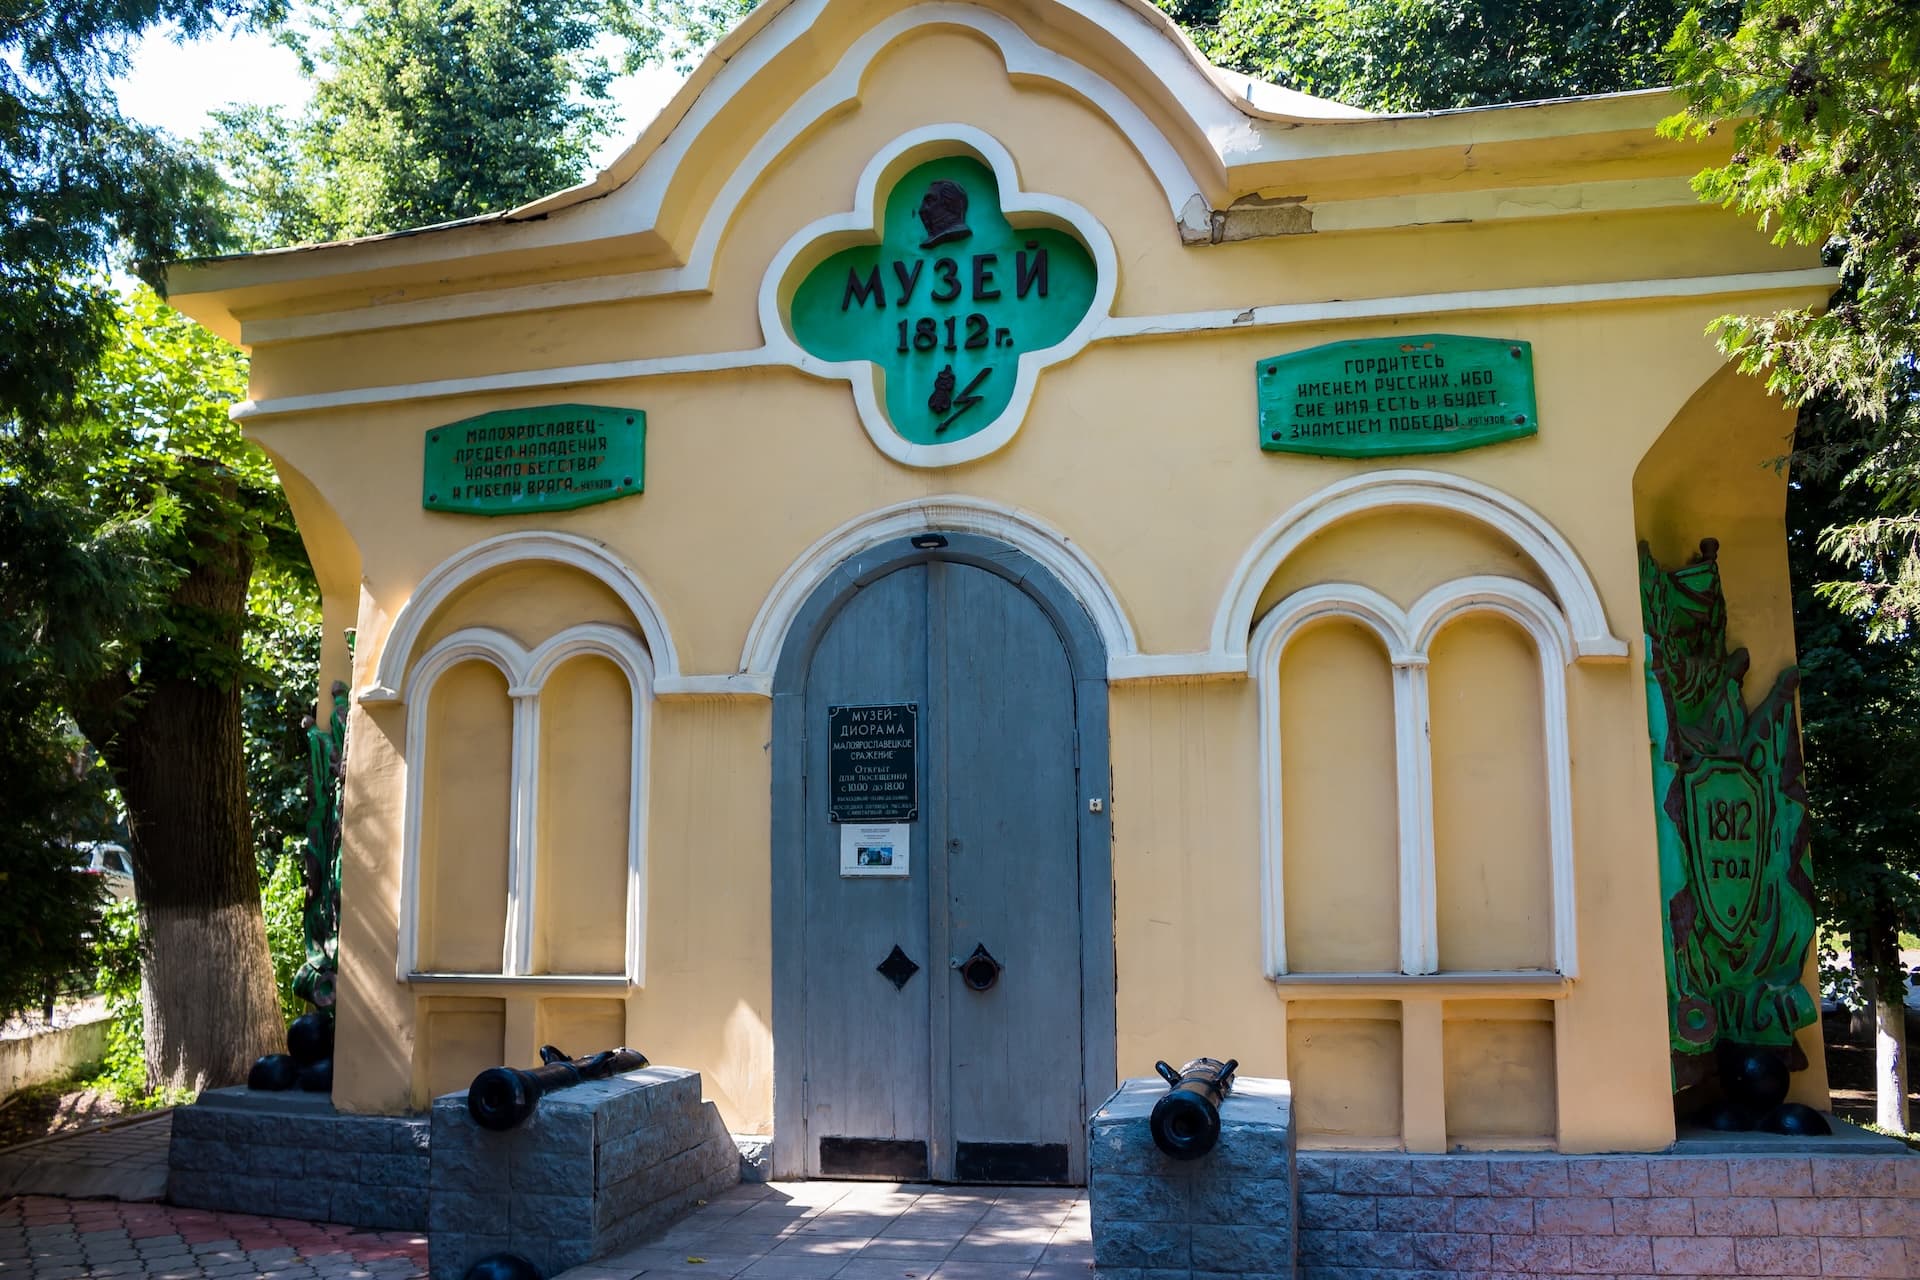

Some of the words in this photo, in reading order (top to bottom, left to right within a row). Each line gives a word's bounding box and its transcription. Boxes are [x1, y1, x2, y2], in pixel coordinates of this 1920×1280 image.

[842, 241, 1048, 311] МУЗЕЙ
[1344, 354, 1444, 374] ГОРДИТЕСЬ
[1298, 380, 1367, 398] ИМЕНЕМ
[1461, 370, 1493, 388] ИБО
[1295, 402, 1325, 418] СИЕ
[1335, 399, 1368, 415] ИМЯ
[1377, 397, 1419, 413] ЕСТЬ
[1427, 394, 1437, 409] И
[1443, 390, 1497, 408] БУДЕТ
[456, 445, 513, 464] ПРЕДЕЛ
[519, 436, 607, 458] НАПАДЕНИЯ
[465, 463, 521, 481] НАЧАЛО
[528, 456, 597, 475] БЕГСТВА
[453, 486, 461, 500] И
[466, 481, 522, 499] ГИБЕЛИ
[841, 723, 905, 737] ДИОРАМА
[1707, 800, 1752, 841] 1812
